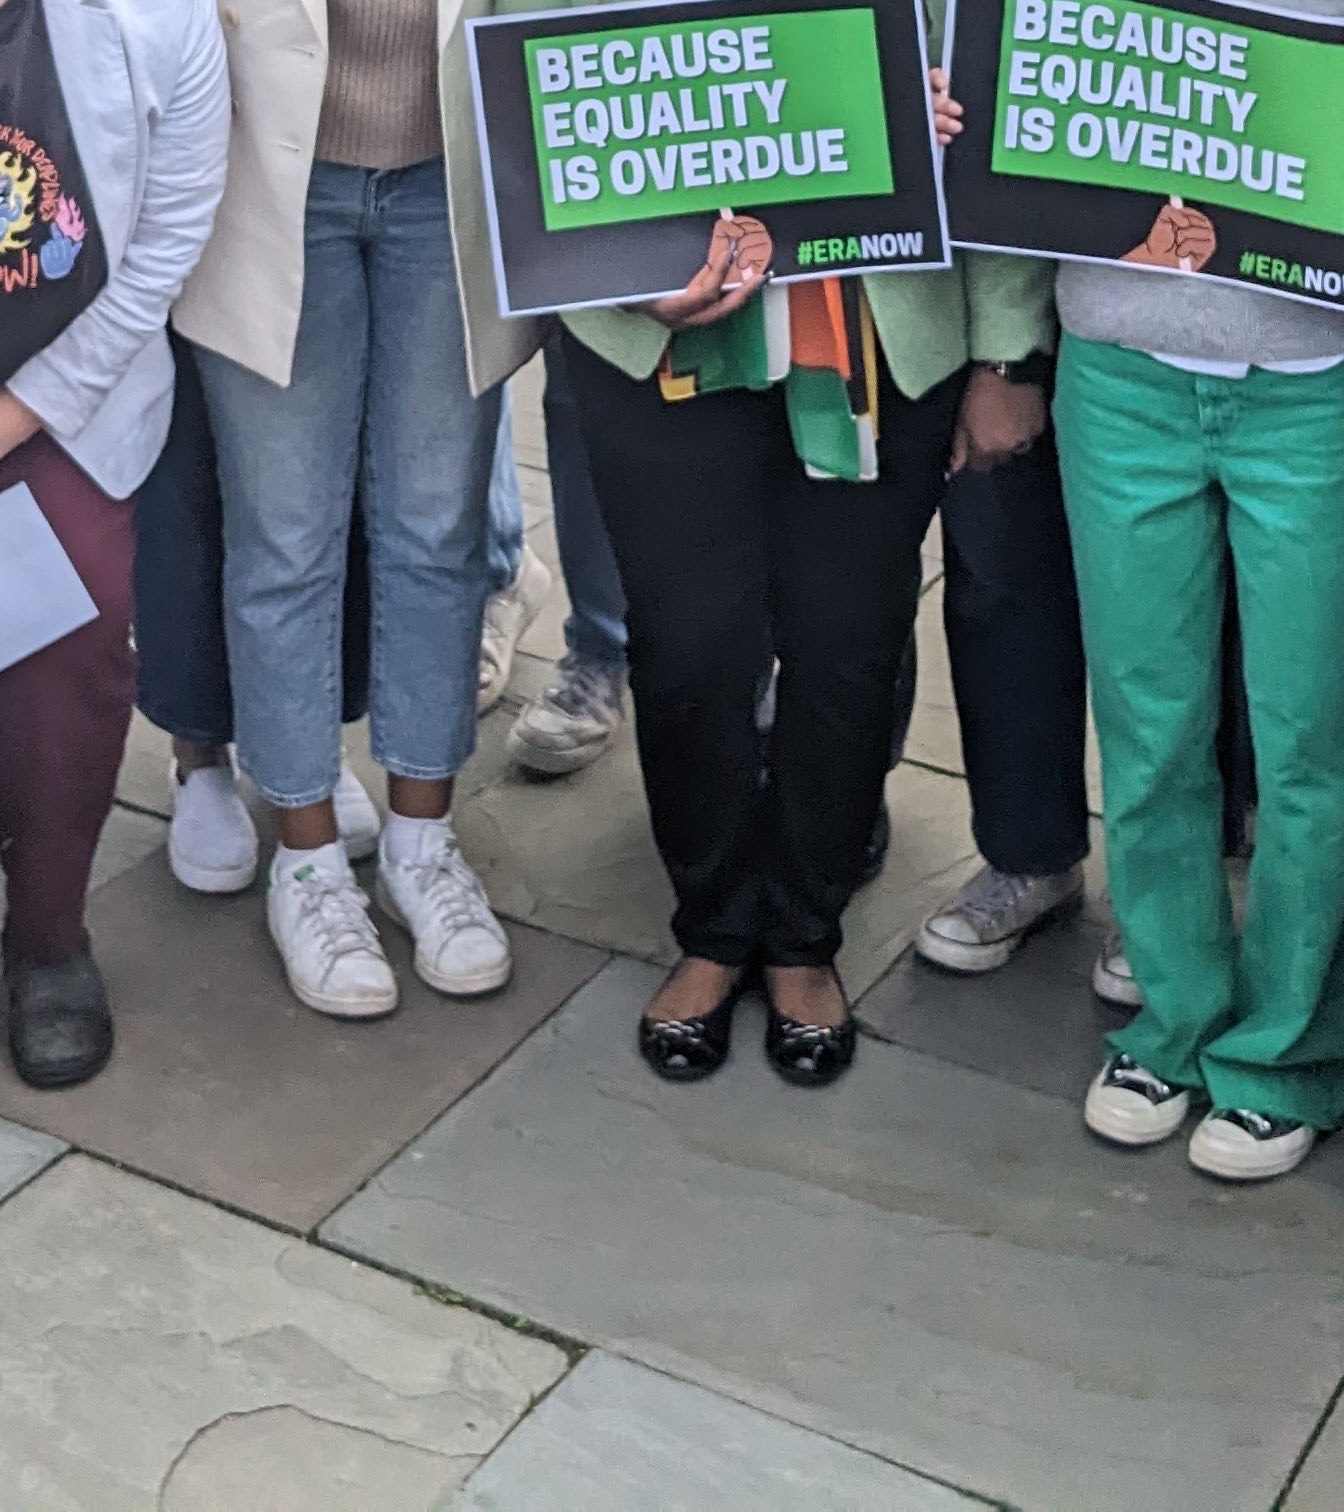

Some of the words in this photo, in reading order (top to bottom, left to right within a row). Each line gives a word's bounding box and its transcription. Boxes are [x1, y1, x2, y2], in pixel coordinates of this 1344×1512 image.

[535, 25, 774, 94] BECAUSE
[1008, 50, 1258, 133] EQUALITY
[543, 79, 787, 148] EQUALITY
[549, 154, 601, 204] IS
[609, 128, 848, 196] OVERDUE
[1004, 104, 1056, 153] IS
[1066, 112, 1306, 201] OVERDUE
[797, 231, 924, 266] #ERANOW
